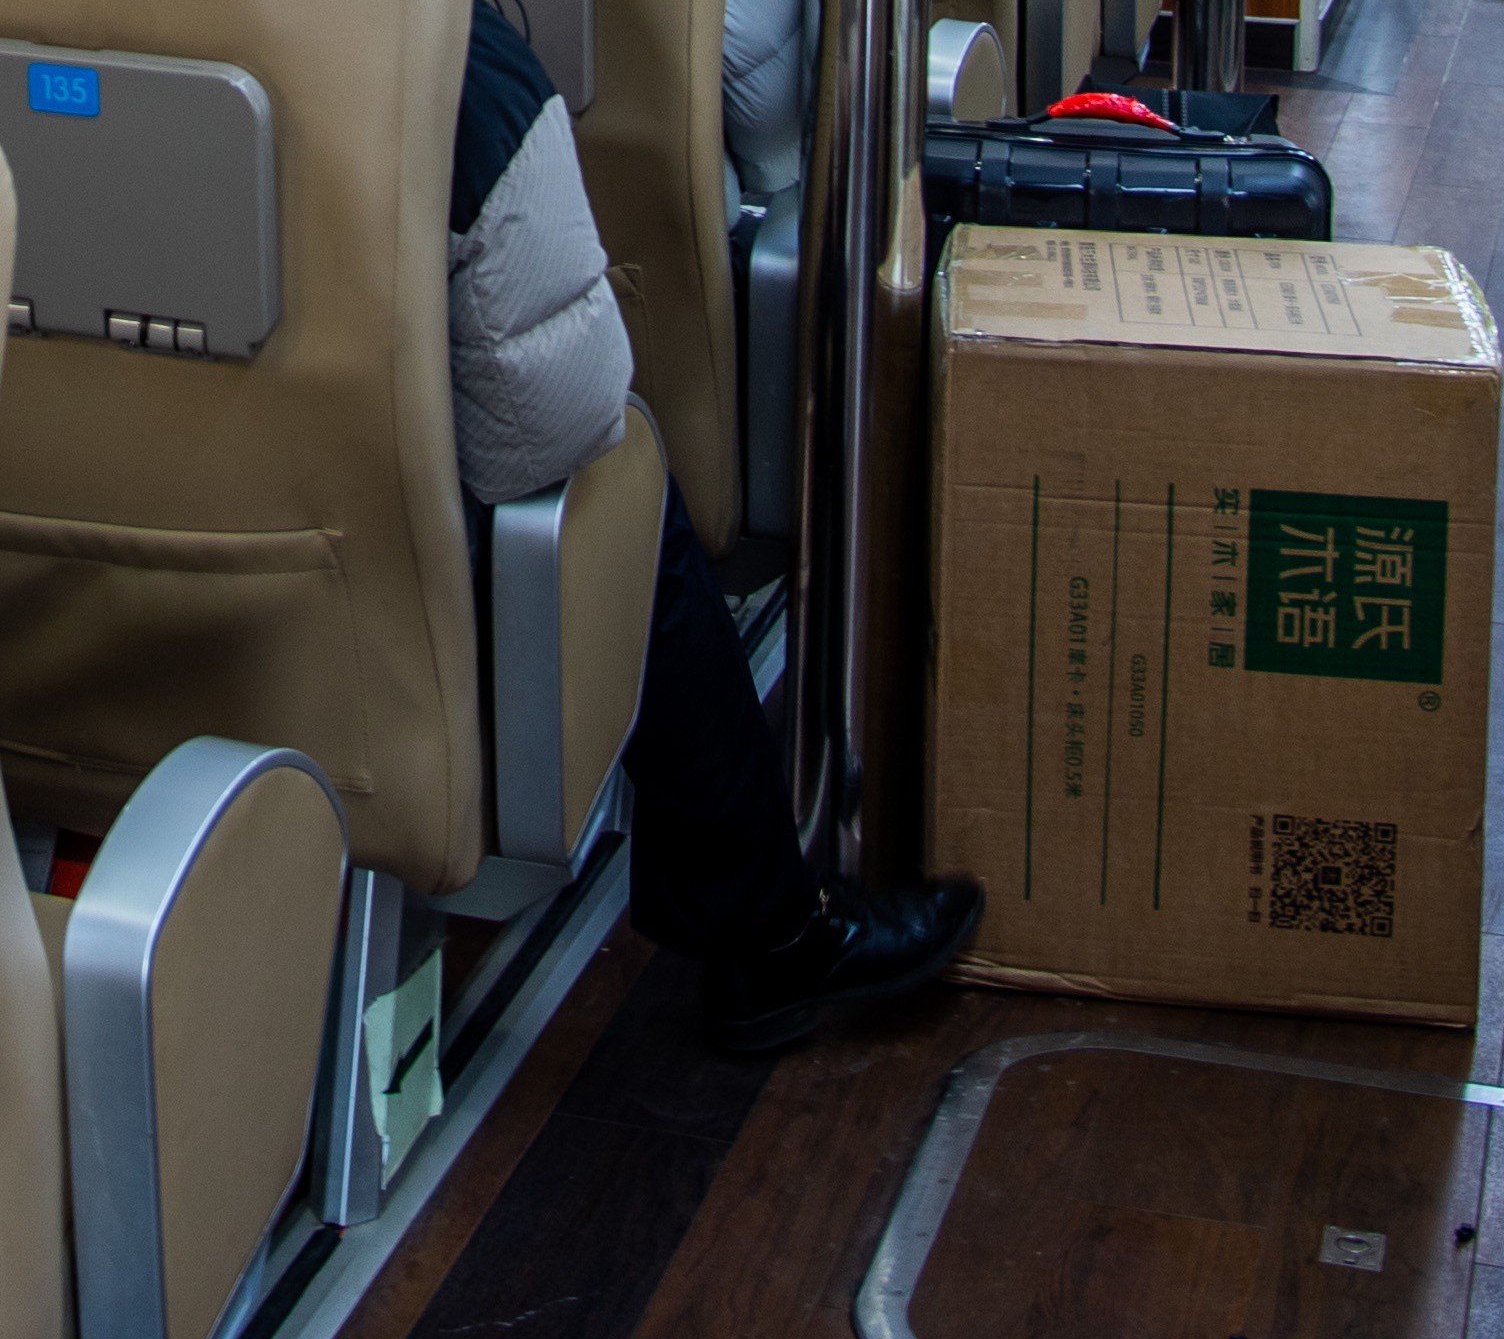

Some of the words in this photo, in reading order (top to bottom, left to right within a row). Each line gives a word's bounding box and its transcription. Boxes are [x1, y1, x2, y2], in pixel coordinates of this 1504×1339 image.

[43, 73, 87, 103] 135
[1276, 522, 1341, 651] 木语
[1352, 523, 1417, 652] 源氏
